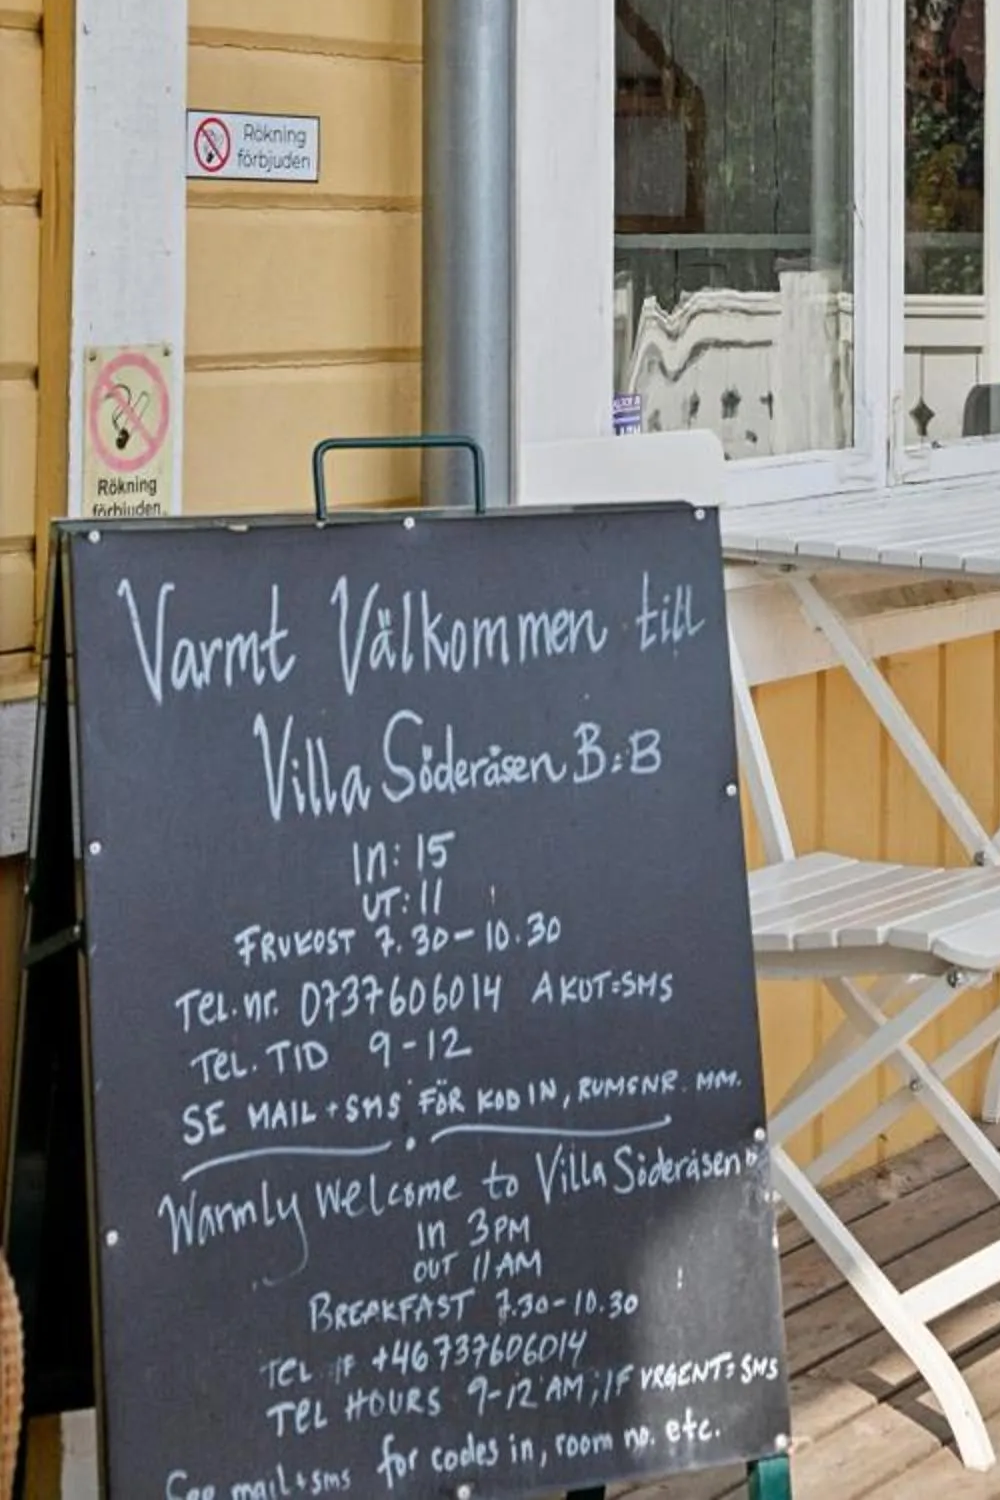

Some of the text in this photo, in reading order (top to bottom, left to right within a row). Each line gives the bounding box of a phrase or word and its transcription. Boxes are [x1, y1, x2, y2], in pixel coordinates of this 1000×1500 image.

[243, 122, 307, 148] Rökning
[237, 148, 311, 173] förbjuden
[97, 476, 157, 497] Rökning
[117, 570, 705, 706] Varmt Välkommen till
[253, 711, 372, 822] Villa
[380, 708, 567, 803] Söderåsen
[416, 830, 456, 872] 15
[419, 876, 443, 915] 11
[265, 1039, 330, 1075] TID
[181, 1100, 227, 1147] SE
[418, 1078, 466, 1116] FÖR
[482, 1159, 520, 1200] to
[535, 1142, 607, 1205] Villa
[344, 1385, 442, 1422] HOURS
[377, 1432, 420, 1490] for
[430, 1432, 500, 1474] codes
[555, 1430, 614, 1458] room
